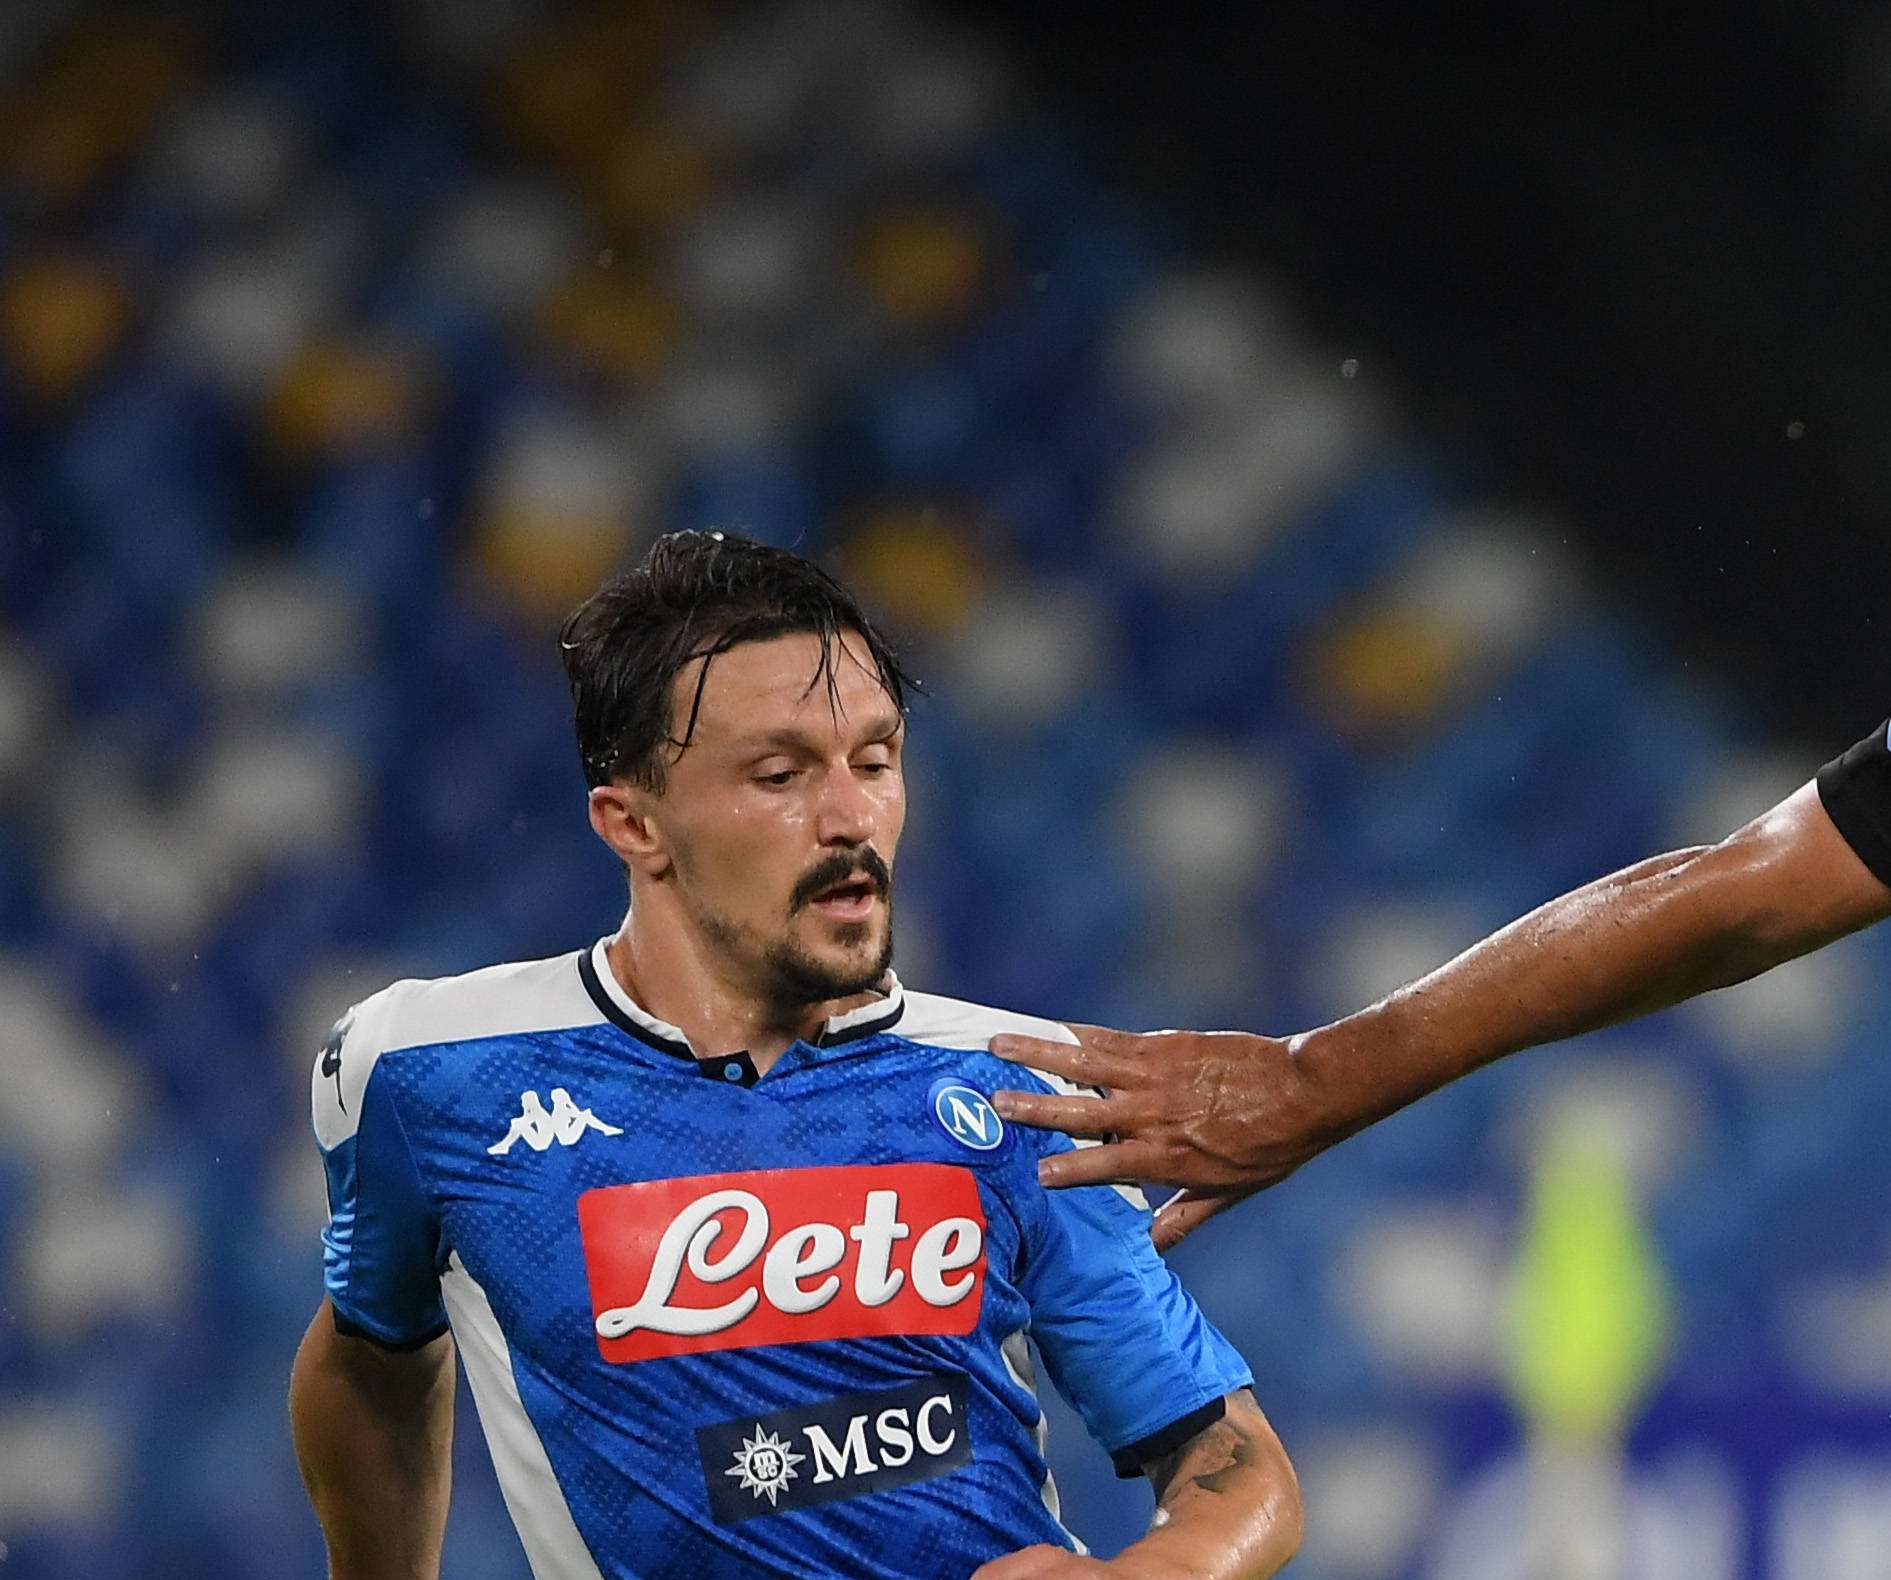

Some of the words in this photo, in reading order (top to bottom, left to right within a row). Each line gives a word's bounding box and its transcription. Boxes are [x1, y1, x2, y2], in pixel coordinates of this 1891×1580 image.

[948, 1095, 987, 1142] N
[595, 1189, 982, 1339] Lete
[802, 1394, 956, 1484] MSC
